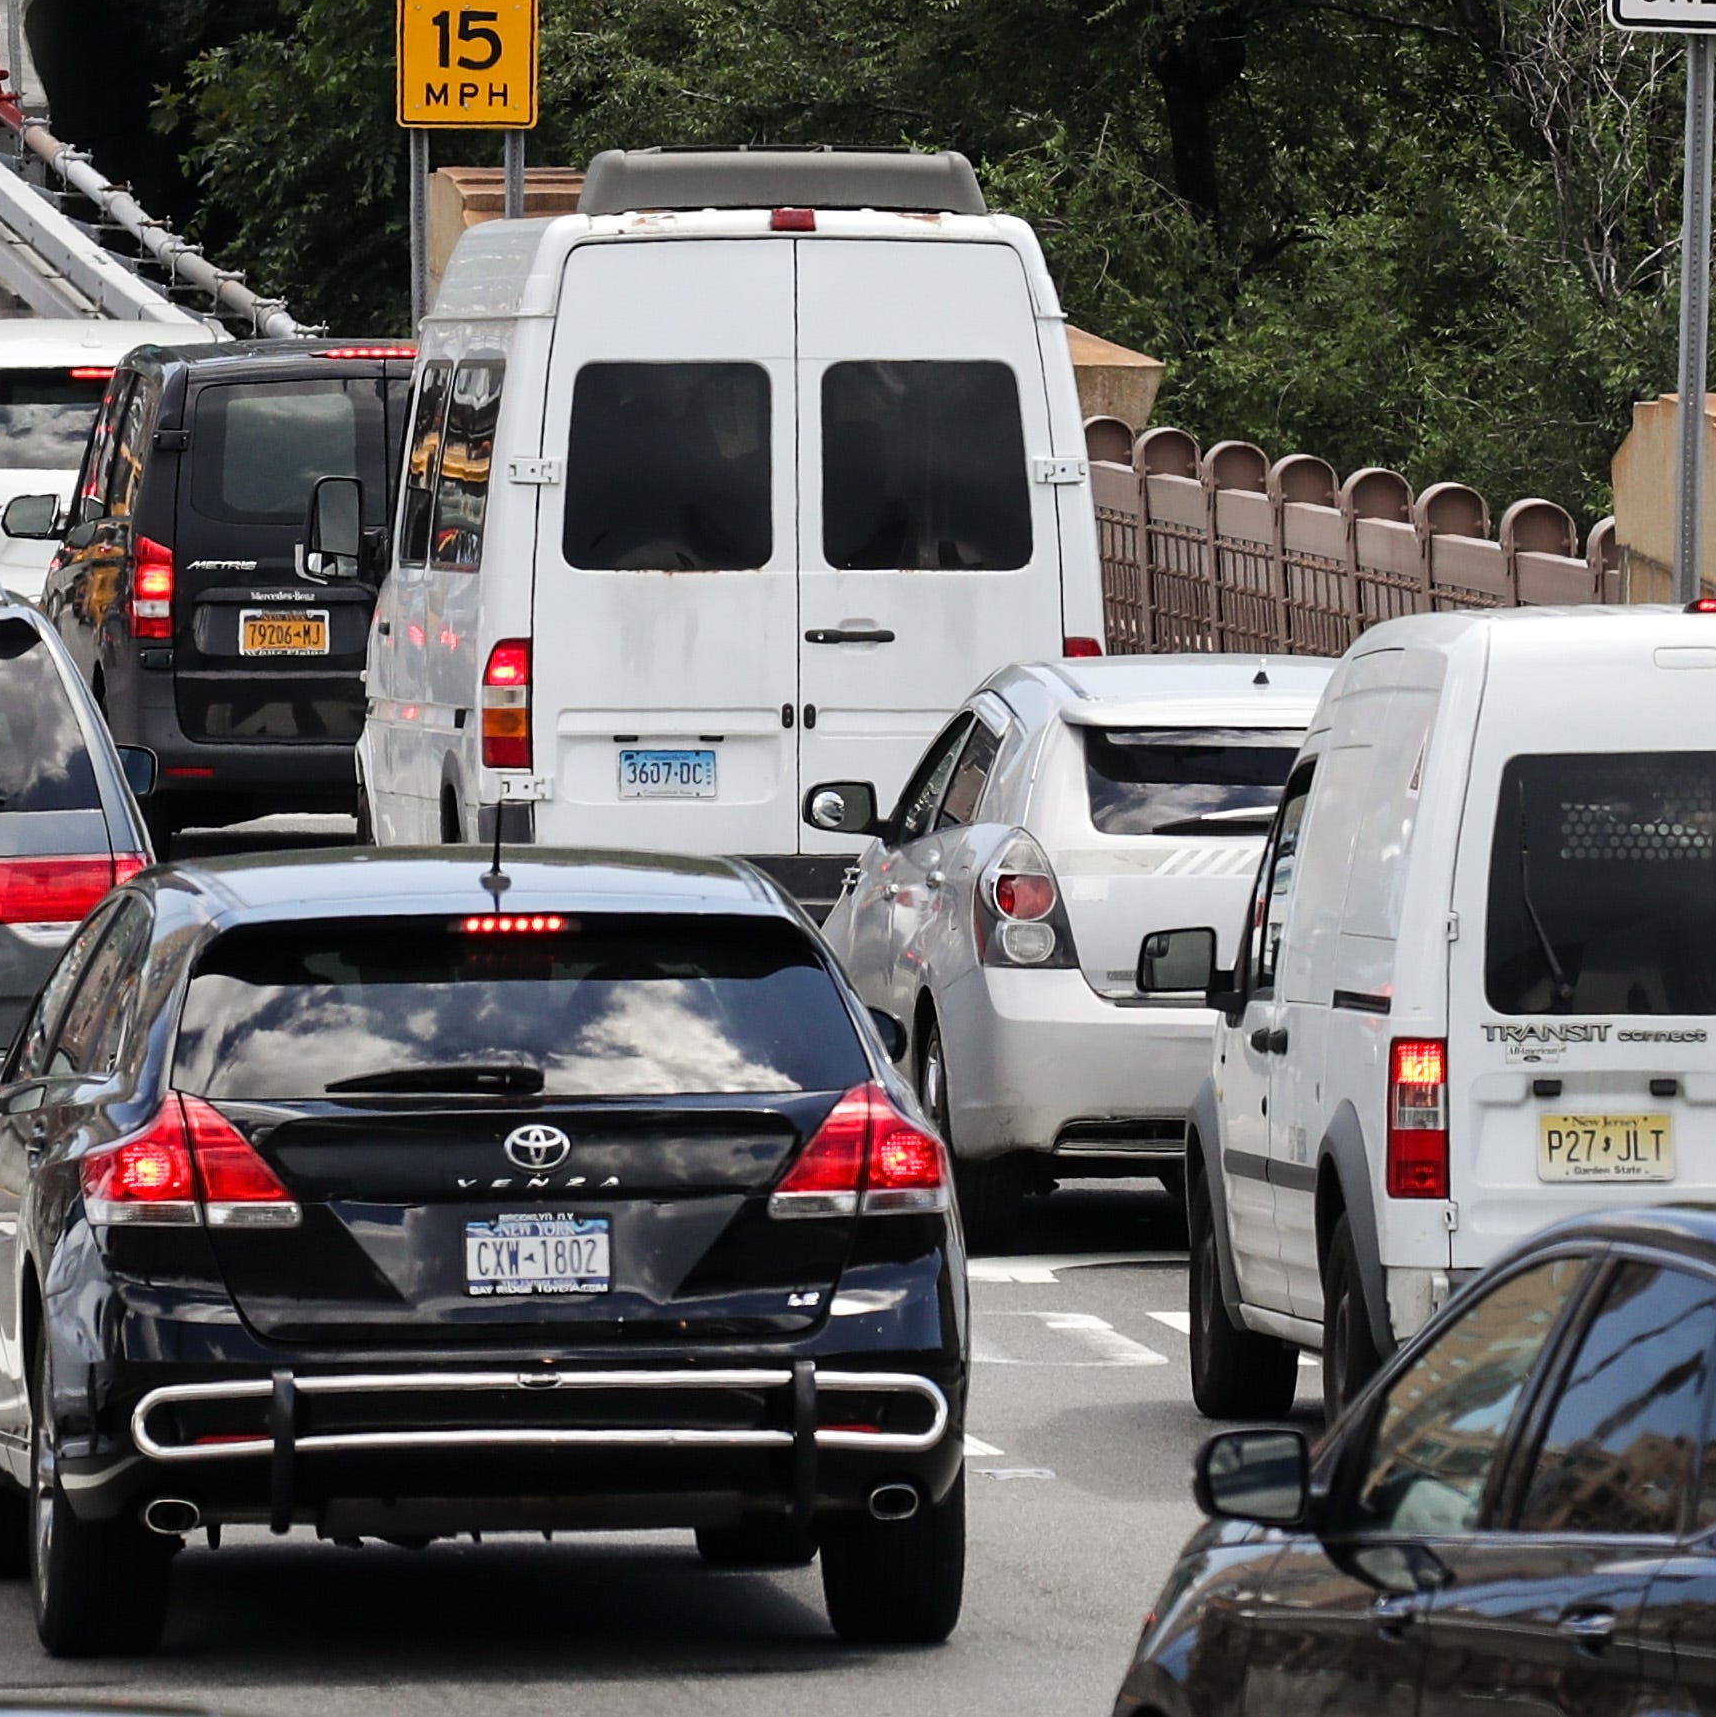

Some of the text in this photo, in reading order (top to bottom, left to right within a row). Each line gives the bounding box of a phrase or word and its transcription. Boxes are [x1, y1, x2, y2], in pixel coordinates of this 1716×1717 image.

[432, 10, 502, 70] 15
[425, 82, 507, 107] MPH
[186, 560, 258, 570] METRIS
[251, 591, 315, 601] Mercedes-Benz
[1481, 1023, 1707, 1043] TRANSIT connect
[1572, 1116, 1639, 1128] New Jersey
[1574, 1165, 1642, 1174] Garden State
[457, 1176, 620, 1188] VENZA
[499, 1222, 576, 1236] NEW YORK
